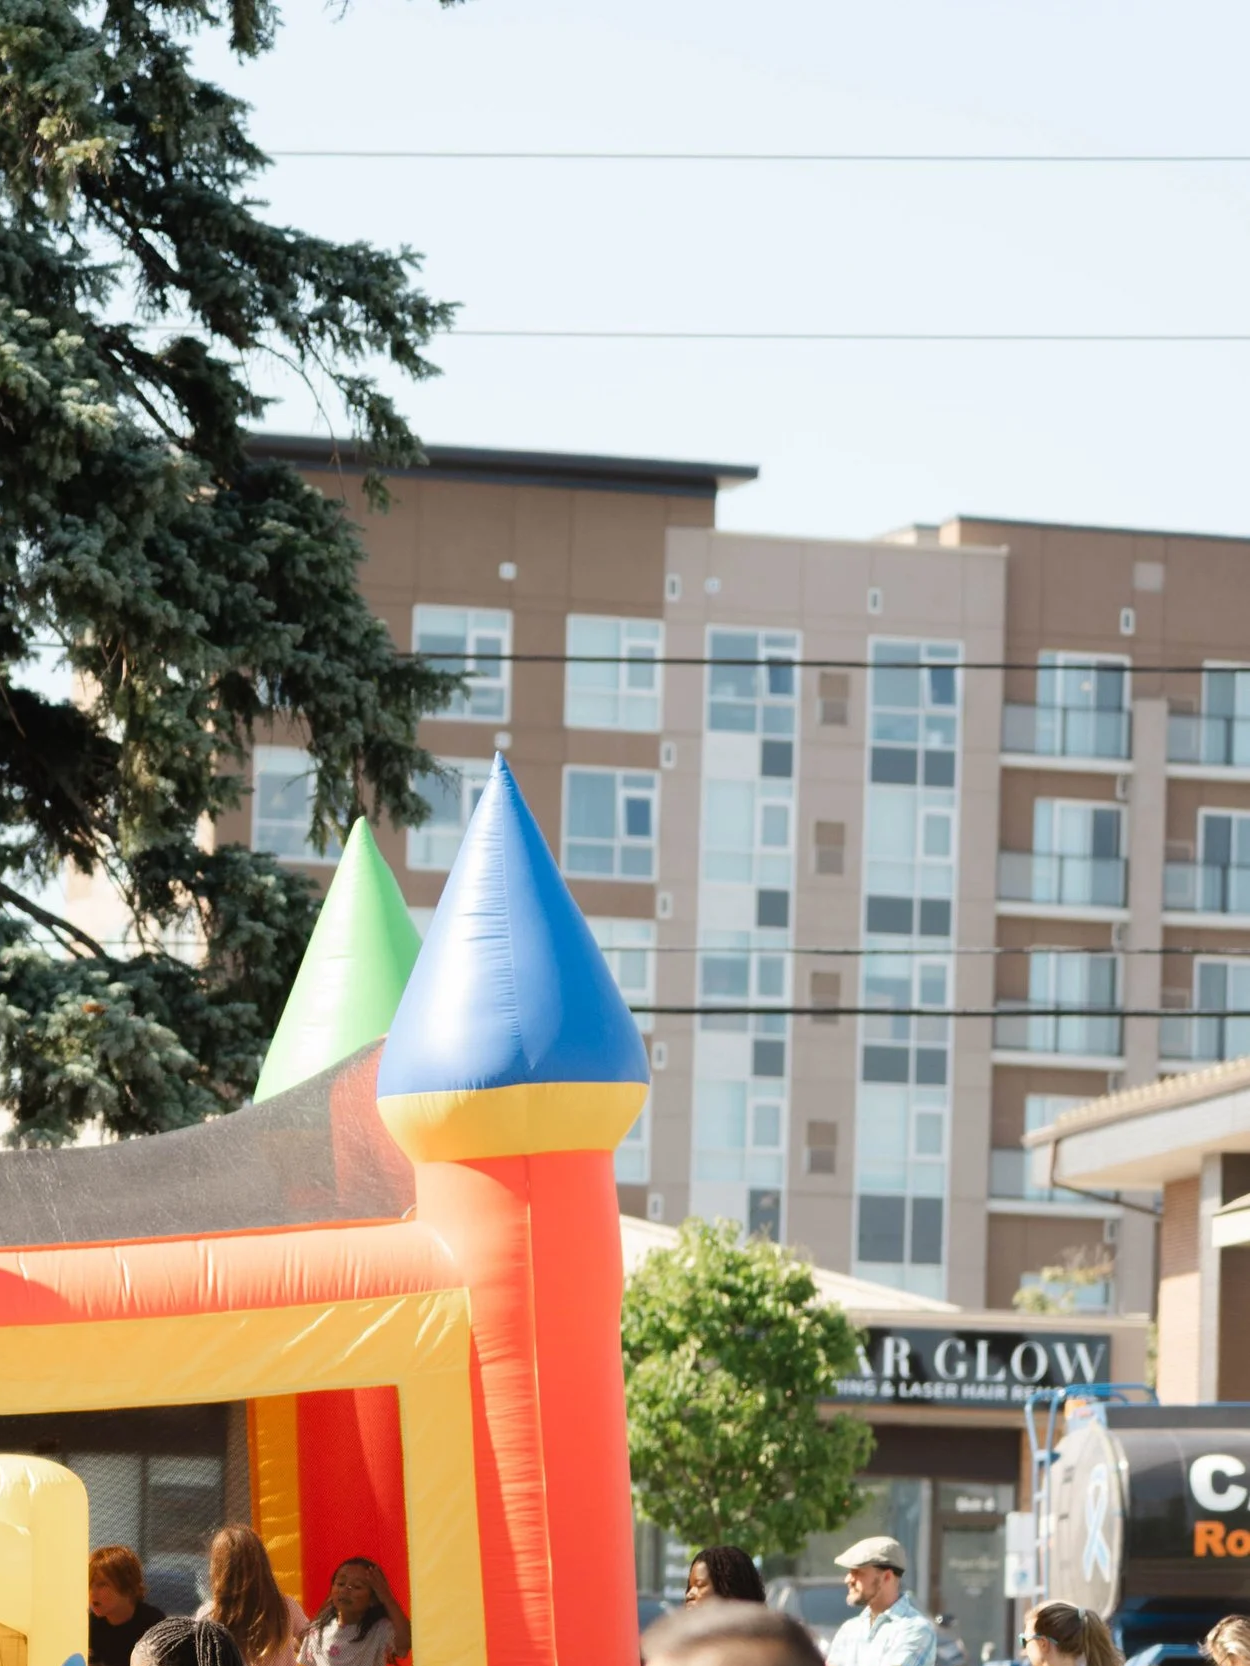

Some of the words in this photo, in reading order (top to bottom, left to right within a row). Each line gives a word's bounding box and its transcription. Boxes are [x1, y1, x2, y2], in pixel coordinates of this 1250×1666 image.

[934, 1337, 1106, 1384] GLOW
[880, 1380, 895, 1398] &
[899, 1381, 956, 1400] LASER
[962, 1383, 1008, 1400] HAIR
[1189, 1453, 1250, 1512] C
